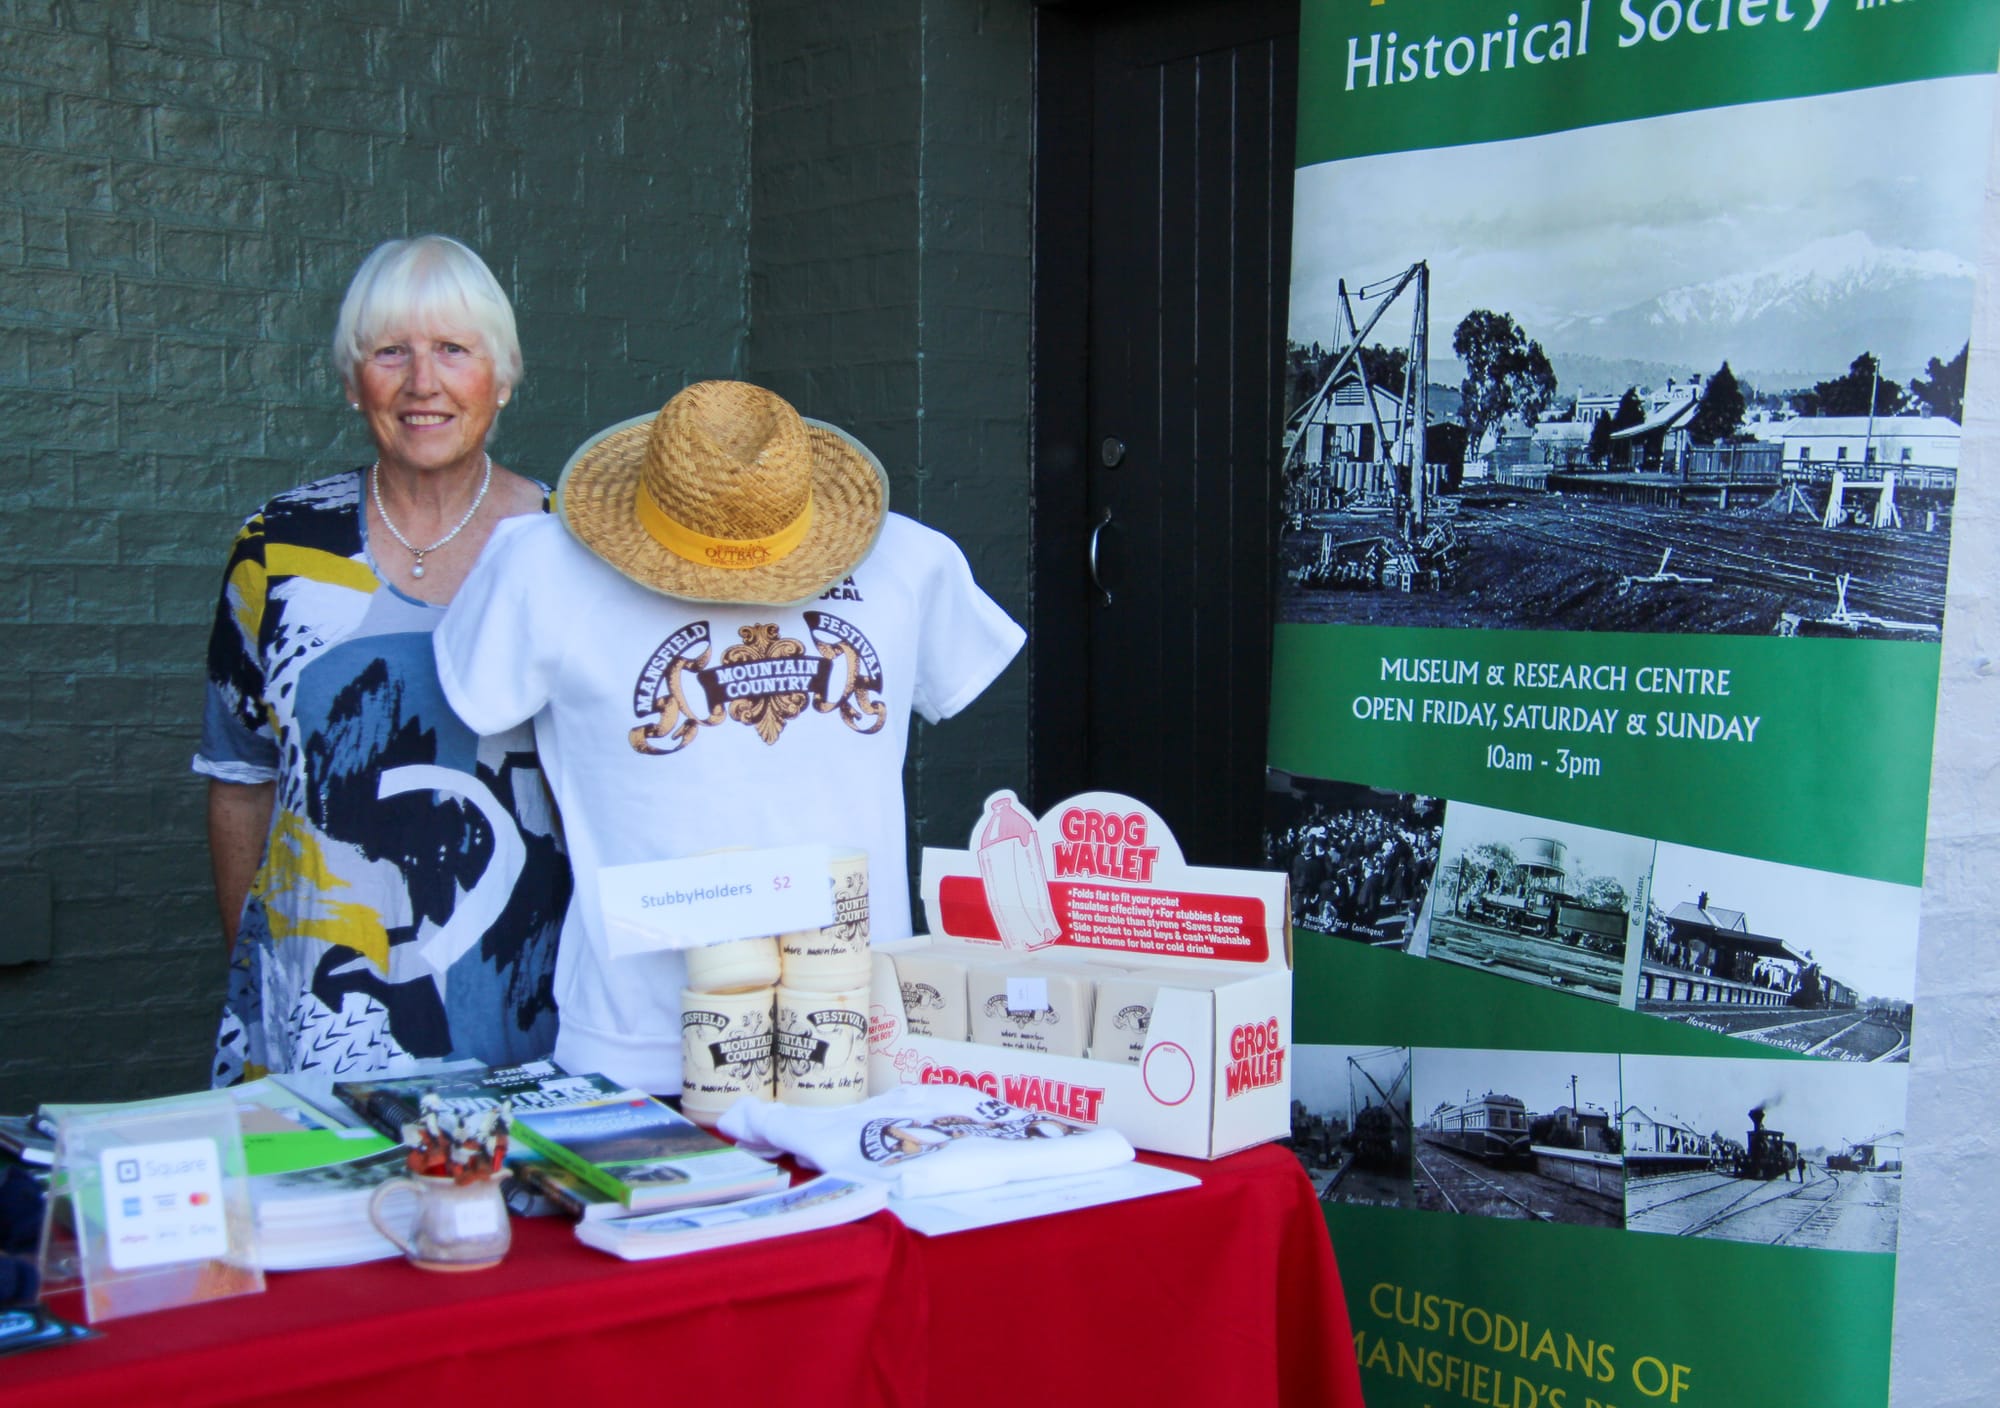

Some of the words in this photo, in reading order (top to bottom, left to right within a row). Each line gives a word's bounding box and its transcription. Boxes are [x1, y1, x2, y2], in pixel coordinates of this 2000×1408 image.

[1345, 0, 1591, 91] Historical
[819, 587, 864, 602] OCAL
[819, 614, 881, 680] FESTIVAL
[637, 624, 707, 713] MANSFIELD
[715, 659, 819, 684] MOUNTAIN
[1381, 657, 1479, 685] MUSEUM
[1486, 665, 1505, 686] &
[1513, 662, 1627, 691] RESEARCH
[1635, 667, 1731, 696] CENTRE
[726, 676, 813, 698] COUNTRY
[1352, 696, 1414, 722] OPEN
[1422, 699, 1498, 731] FRIDAY,
[1503, 703, 1619, 734] SATURDAY
[1626, 713, 1647, 736] &
[1656, 711, 1761, 742] SUNDAY
[1486, 744, 1533, 771] 10am
[1556, 748, 1600, 779] 3pm
[1059, 806, 1148, 848] GROG
[1052, 841, 1160, 883] WALLET
[641, 882, 753, 908] StubbyHolders
[773, 875, 792, 891] $2
[1072, 888, 1094, 899] Folds
[1096, 890, 1110, 900] flat
[1111, 892, 1120, 901] to
[1121, 893, 1130, 902] fit
[1132, 895, 1150, 905] your
[1151, 896, 1180, 907] pocket
[1071, 899, 1109, 912] Insulates
[1111, 904, 1154, 918] effectively
[1161, 907, 1174, 918] For
[1176, 910, 1213, 921] stubbies
[1214, 912, 1220, 922] &
[1222, 915, 1244, 924] cans
[1071, 910, 1092, 921] More
[1094, 913, 1125, 925] durable
[1126, 917, 1145, 926] than
[1147, 918, 1179, 930] styrene
[1186, 921, 1212, 932] Saves
[1213, 925, 1240, 934] space
[1072, 921, 1092, 932] Side
[1093, 925, 1121, 935] pocket
[1123, 927, 1132, 936] to
[1133, 928, 1152, 938] hold
[1154, 930, 1173, 941] keys
[1175, 931, 1181, 940] &
[1183, 933, 1204, 942] cash
[1208, 934, 1251, 946] Washable
[1074, 932, 1090, 943] Use
[1092, 935, 1101, 945] at
[1102, 936, 1125, 946] home
[1127, 938, 1139, 948] for
[1140, 939, 1154, 949] hot
[1155, 942, 1165, 950] or
[1166, 942, 1184, 952] cold
[1186, 943, 1214, 954] drinks
[814, 1010, 864, 1029] FESTIVAL
[1230, 1015, 1279, 1063] GROG
[1752, 1032, 1810, 1051] Mansfield
[1225, 1045, 1286, 1101] WALLET
[1002, 1073, 1105, 1125] WALLET
[1370, 1283, 1615, 1382] CUSTODIANS
[1632, 1356, 1692, 1403] OF
